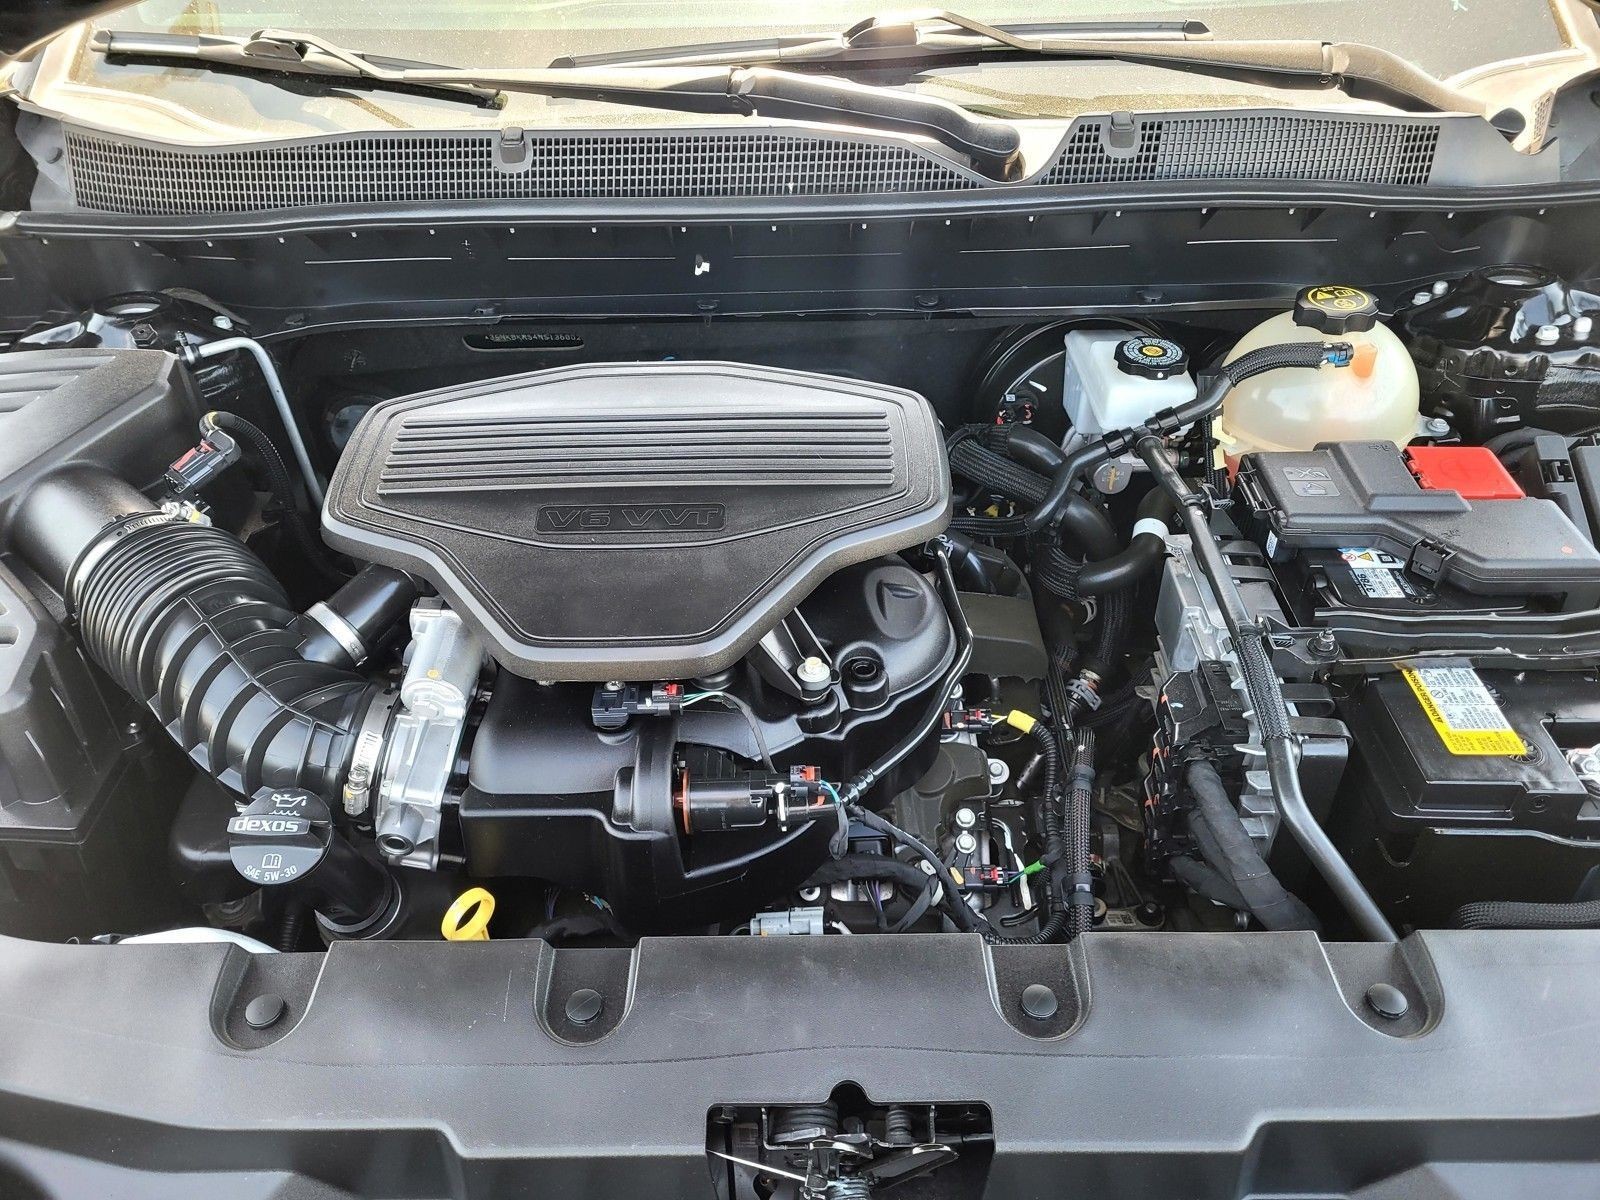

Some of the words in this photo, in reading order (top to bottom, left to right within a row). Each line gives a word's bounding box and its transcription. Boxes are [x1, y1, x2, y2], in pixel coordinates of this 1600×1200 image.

[546, 509, 611, 528] V6
[622, 508, 719, 527] VVT
[1357, 573, 1376, 593] 3786
[234, 816, 300, 832] dexos
[243, 864, 262, 880] SAE
[263, 865, 298, 881] 5W-30
